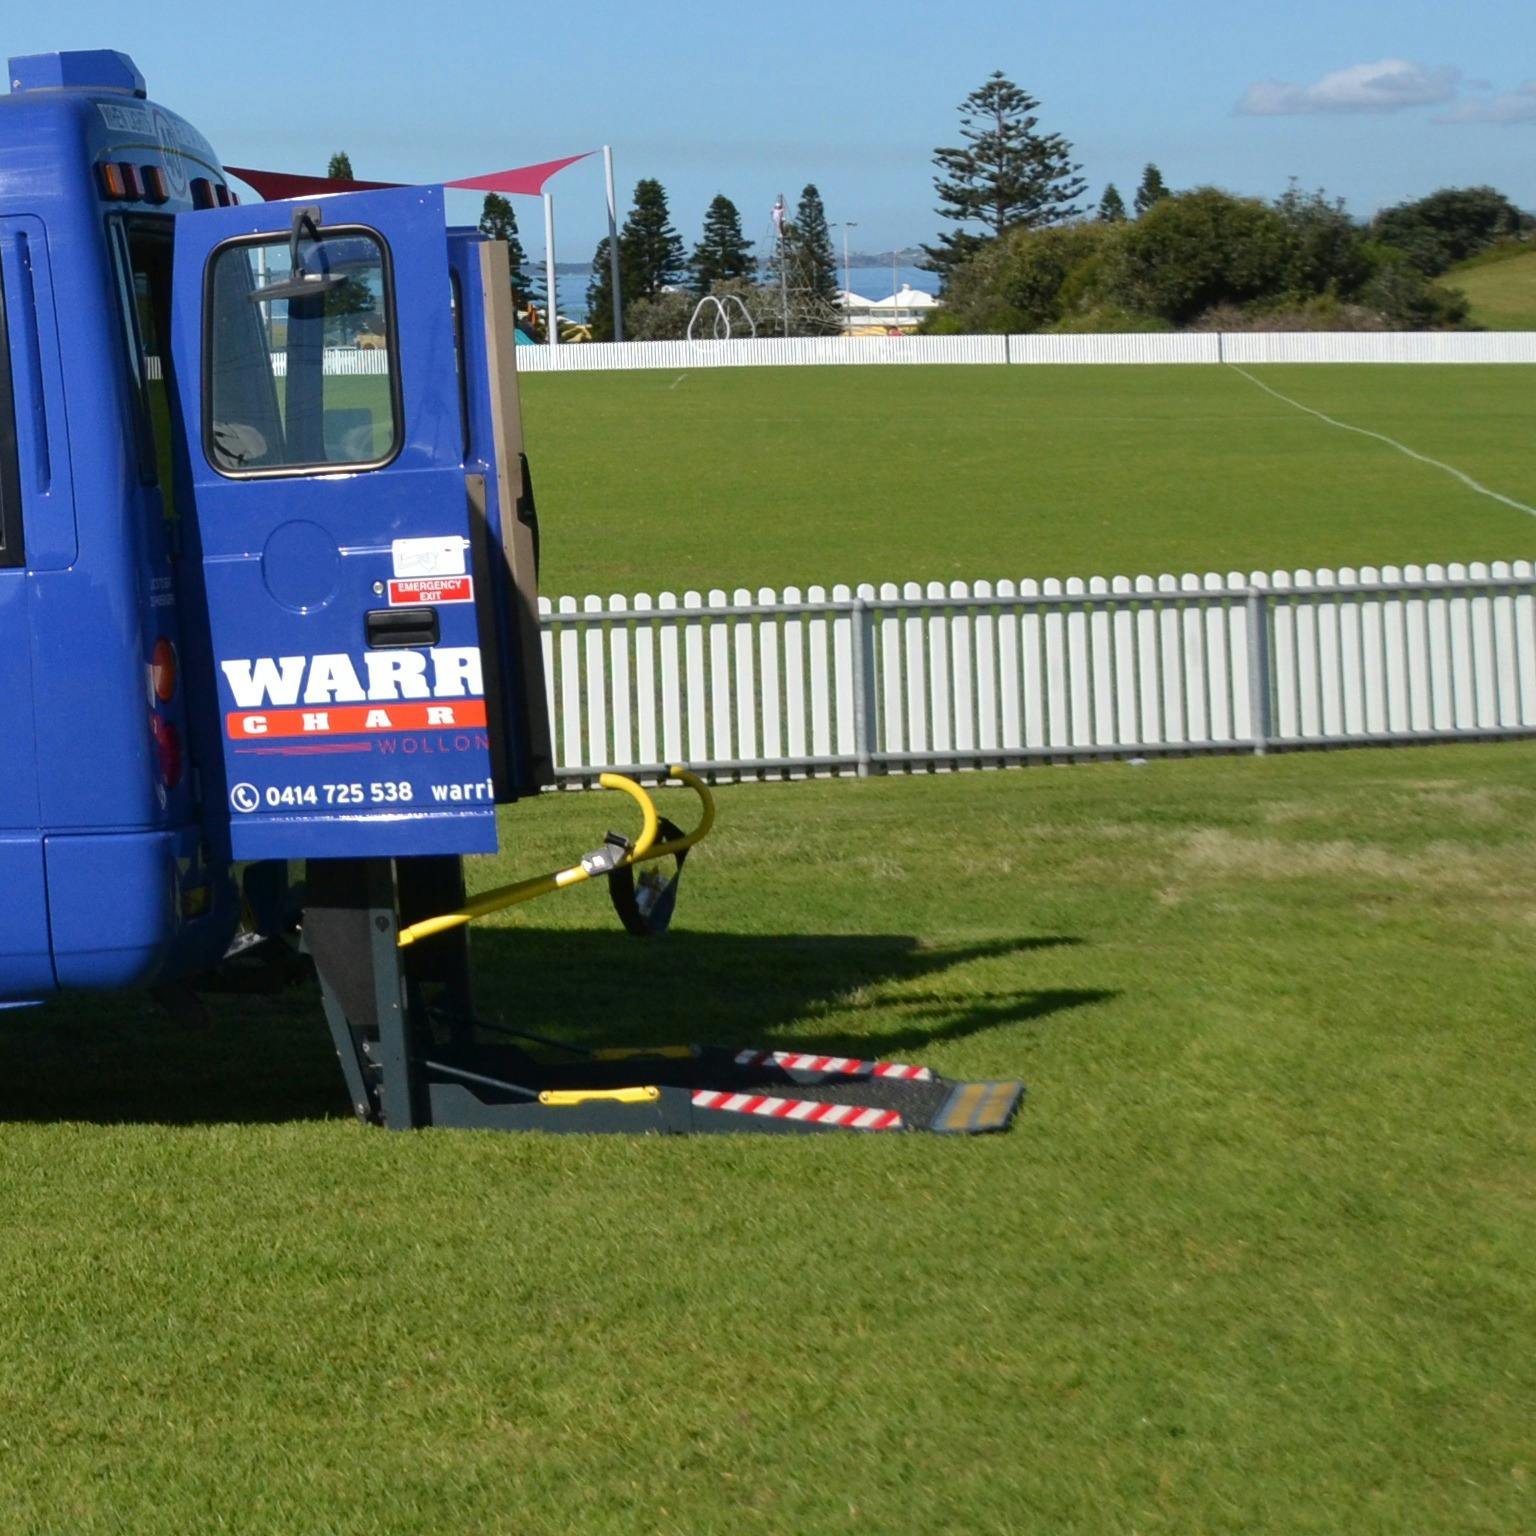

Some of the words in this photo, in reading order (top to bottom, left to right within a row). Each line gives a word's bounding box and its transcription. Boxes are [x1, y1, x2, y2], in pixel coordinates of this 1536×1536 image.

[398, 580, 462, 593] EMERGENCY
[419, 591, 443, 601] EXIT
[221, 647, 485, 708] WARR
[242, 706, 456, 734] CHAR
[266, 785, 318, 807] 0414
[323, 783, 365, 804] 725
[370, 782, 414, 802] 538
[431, 778, 494, 801] warri
